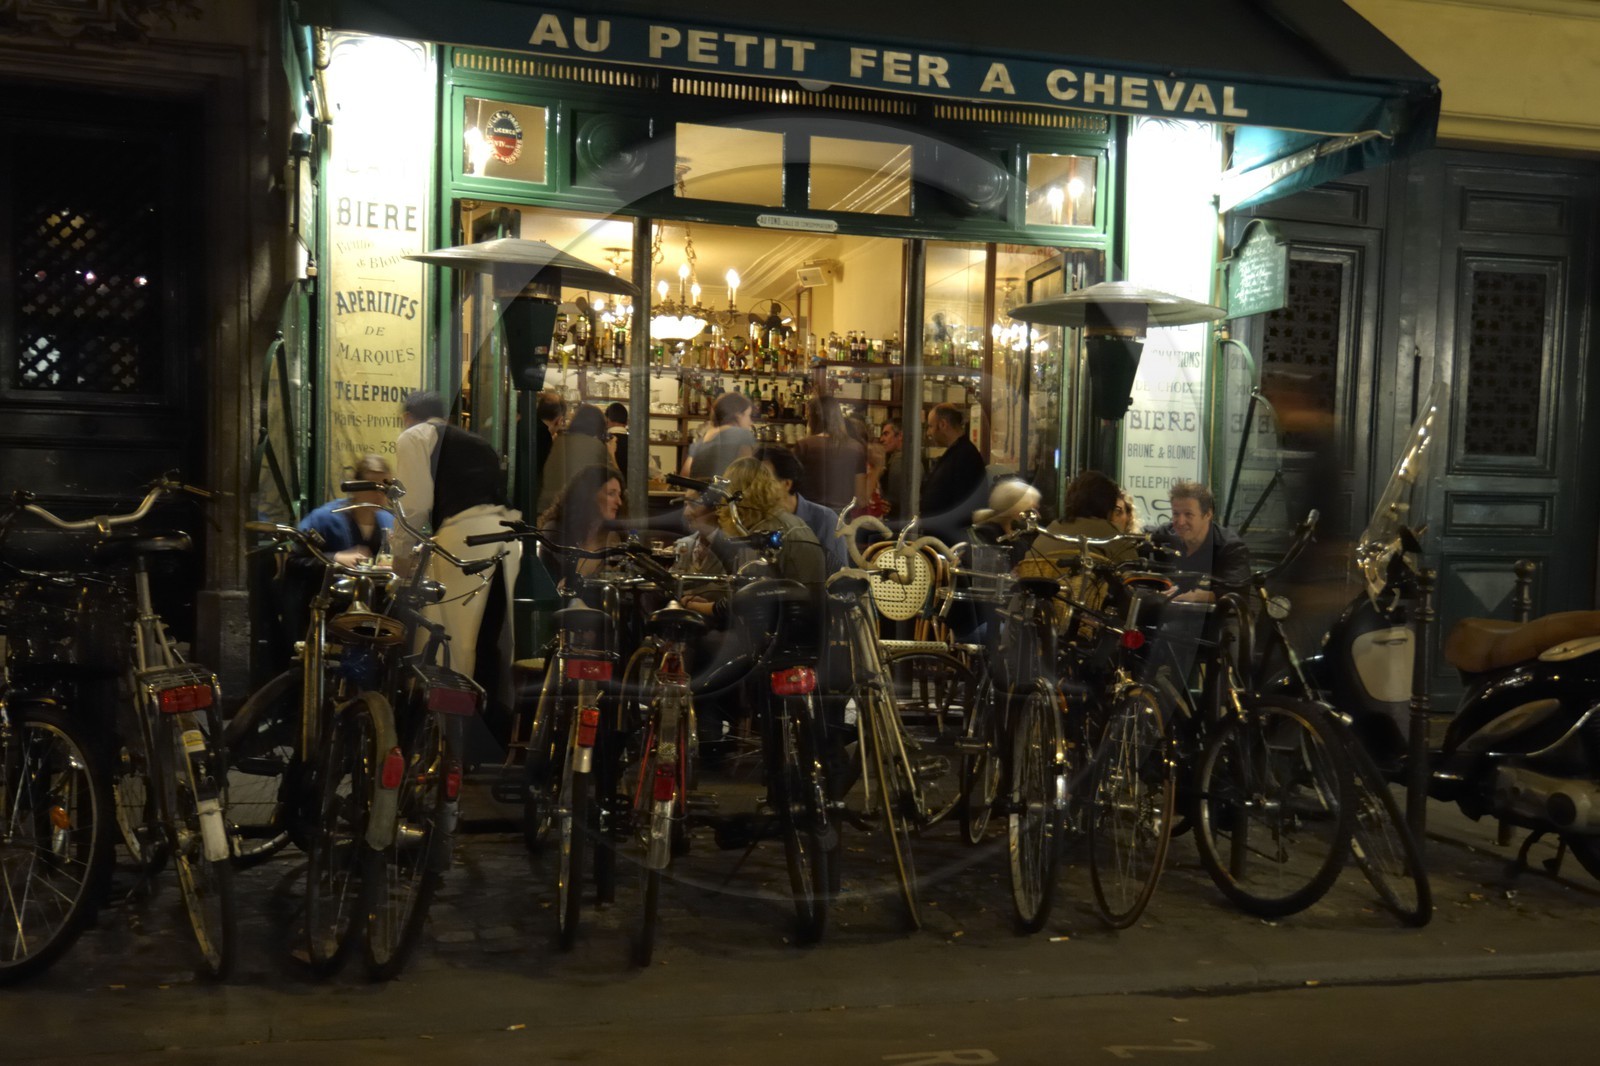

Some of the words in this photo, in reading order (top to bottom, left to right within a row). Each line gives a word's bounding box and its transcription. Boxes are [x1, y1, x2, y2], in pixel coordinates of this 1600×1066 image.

[529, 13, 611, 53] AU
[649, 25, 816, 72] PETIT
[849, 46, 951, 89] FER
[980, 62, 1016, 95] A
[1046, 68, 1249, 118] CHEVAL
[508, 113, 522, 133] PARIS
[364, 326, 386, 336] DE
[336, 342, 416, 366] MARQUES
[334, 380, 416, 403] TÉLÉPHON
[1129, 409, 1196, 432] BIERE
[1127, 443, 1155, 459] BRUNE
[1157, 446, 1166, 459] &
[1166, 444, 1197, 460] BLONDE
